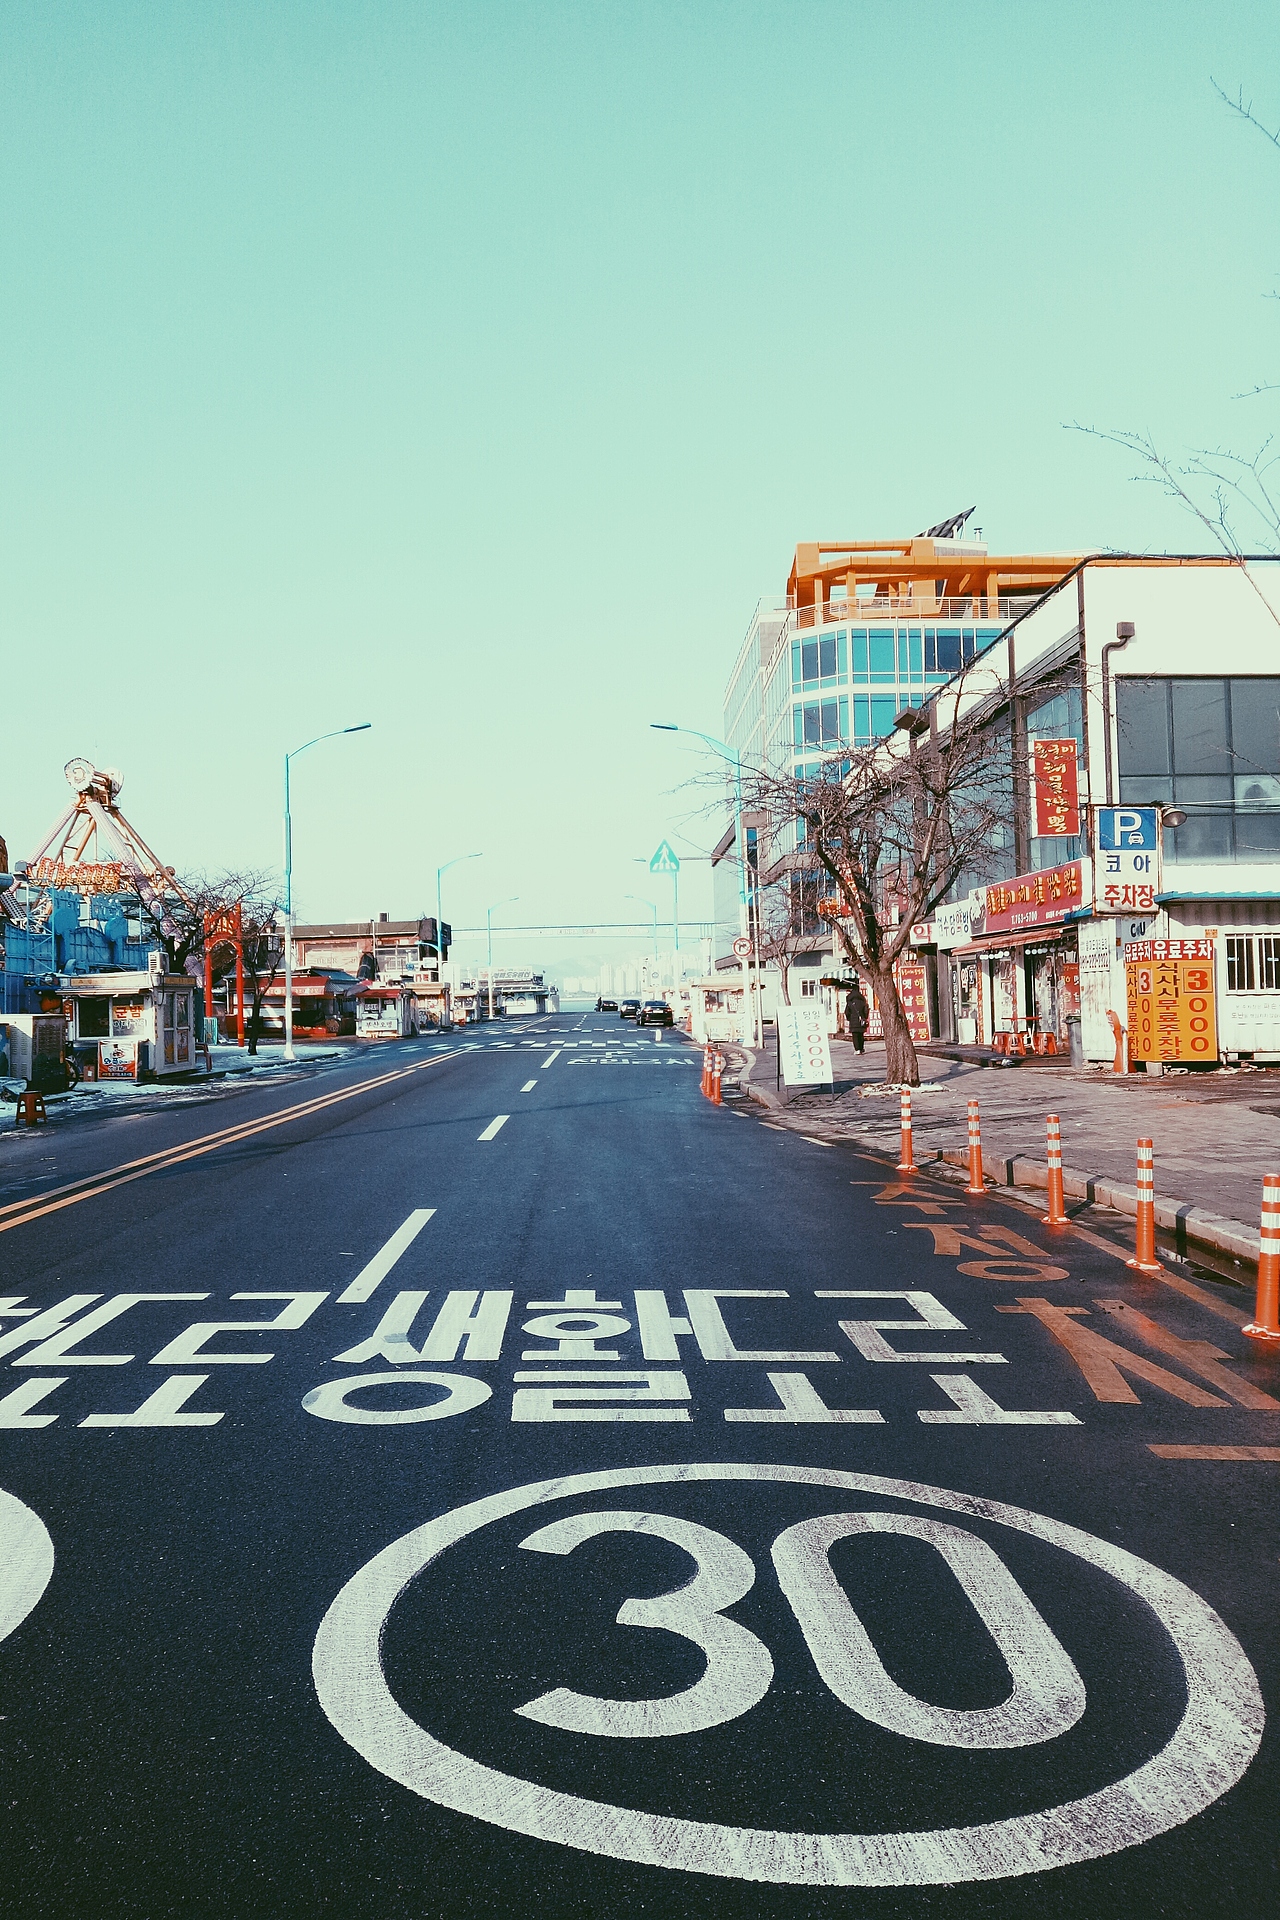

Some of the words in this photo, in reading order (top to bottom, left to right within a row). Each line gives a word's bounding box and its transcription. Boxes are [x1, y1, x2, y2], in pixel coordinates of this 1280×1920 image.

[1114, 811, 1142, 847] P
[1105, 854, 1151, 874] 코아
[1104, 884, 1155, 908] 주차장
[913, 924, 932, 943] 약
[1153, 939, 1212, 960] 유료주차
[1125, 941, 1151, 963] 유료주차
[1140, 971, 1151, 1053] 3000
[1187, 969, 1210, 1053] 3000
[807, 1022, 825, 1068] 3000
[302, 1288, 1085, 1427] 생활도로
[513, 1507, 1089, 1752] 30
